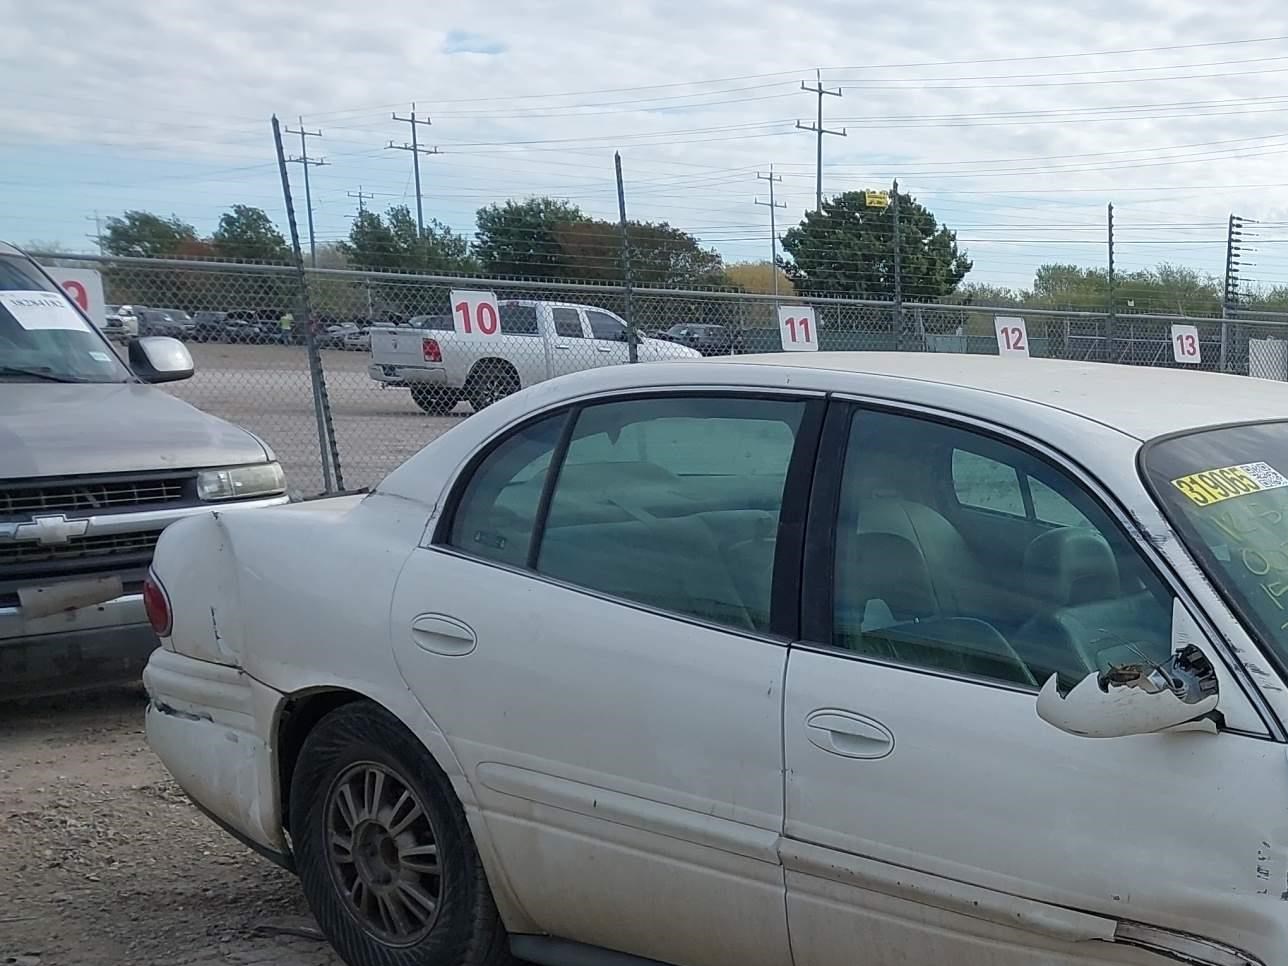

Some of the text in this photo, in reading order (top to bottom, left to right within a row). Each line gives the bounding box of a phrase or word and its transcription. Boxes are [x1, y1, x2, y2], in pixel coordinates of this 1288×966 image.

[456, 301, 497, 335] 10
[785, 317, 811, 343] 11
[1000, 327, 1025, 350] 12
[1176, 334, 1197, 356] 13
[1175, 466, 1260, 504] 319065
